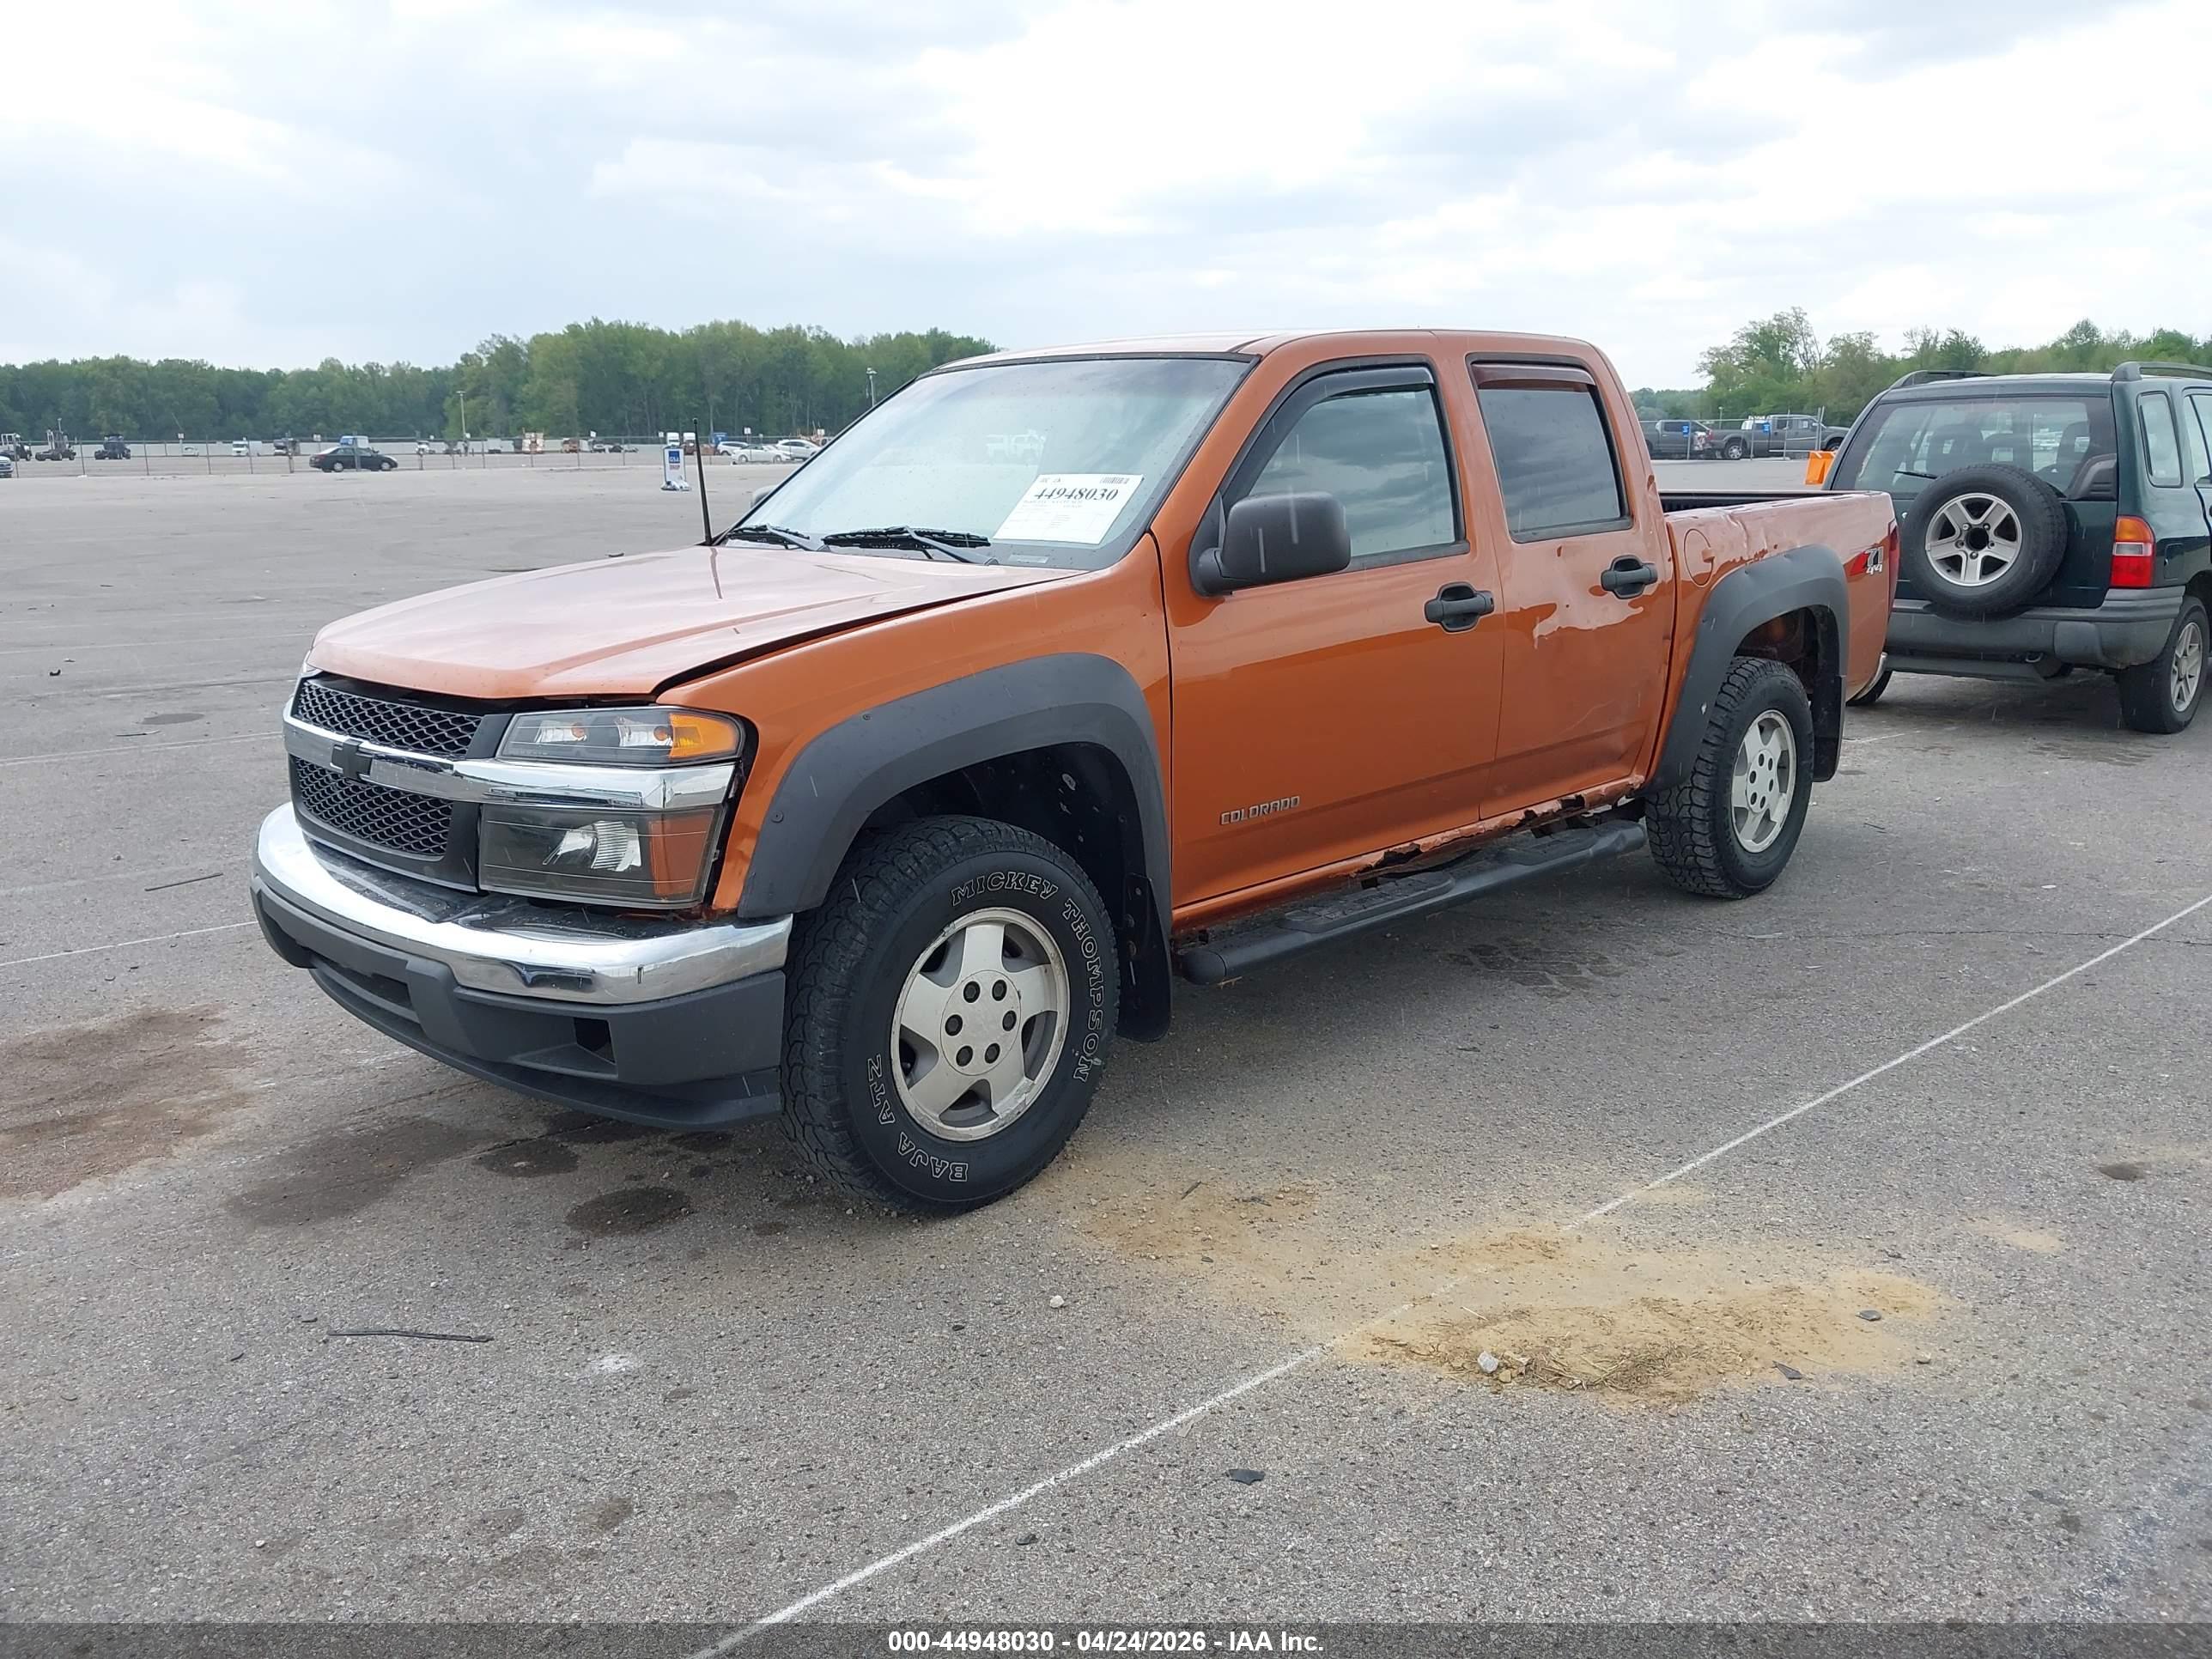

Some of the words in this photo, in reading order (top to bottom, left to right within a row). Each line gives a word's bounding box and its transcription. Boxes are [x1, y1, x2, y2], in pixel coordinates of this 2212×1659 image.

[1034, 487, 1119, 501] 44948030
[1220, 795, 1300, 825] COLORADO
[951, 871, 1059, 906] MICKEY
[1061, 898, 1104, 1083] THOMPSON
[867, 1054, 896, 1125] ATZ
[897, 1132, 969, 1182] BAJA
